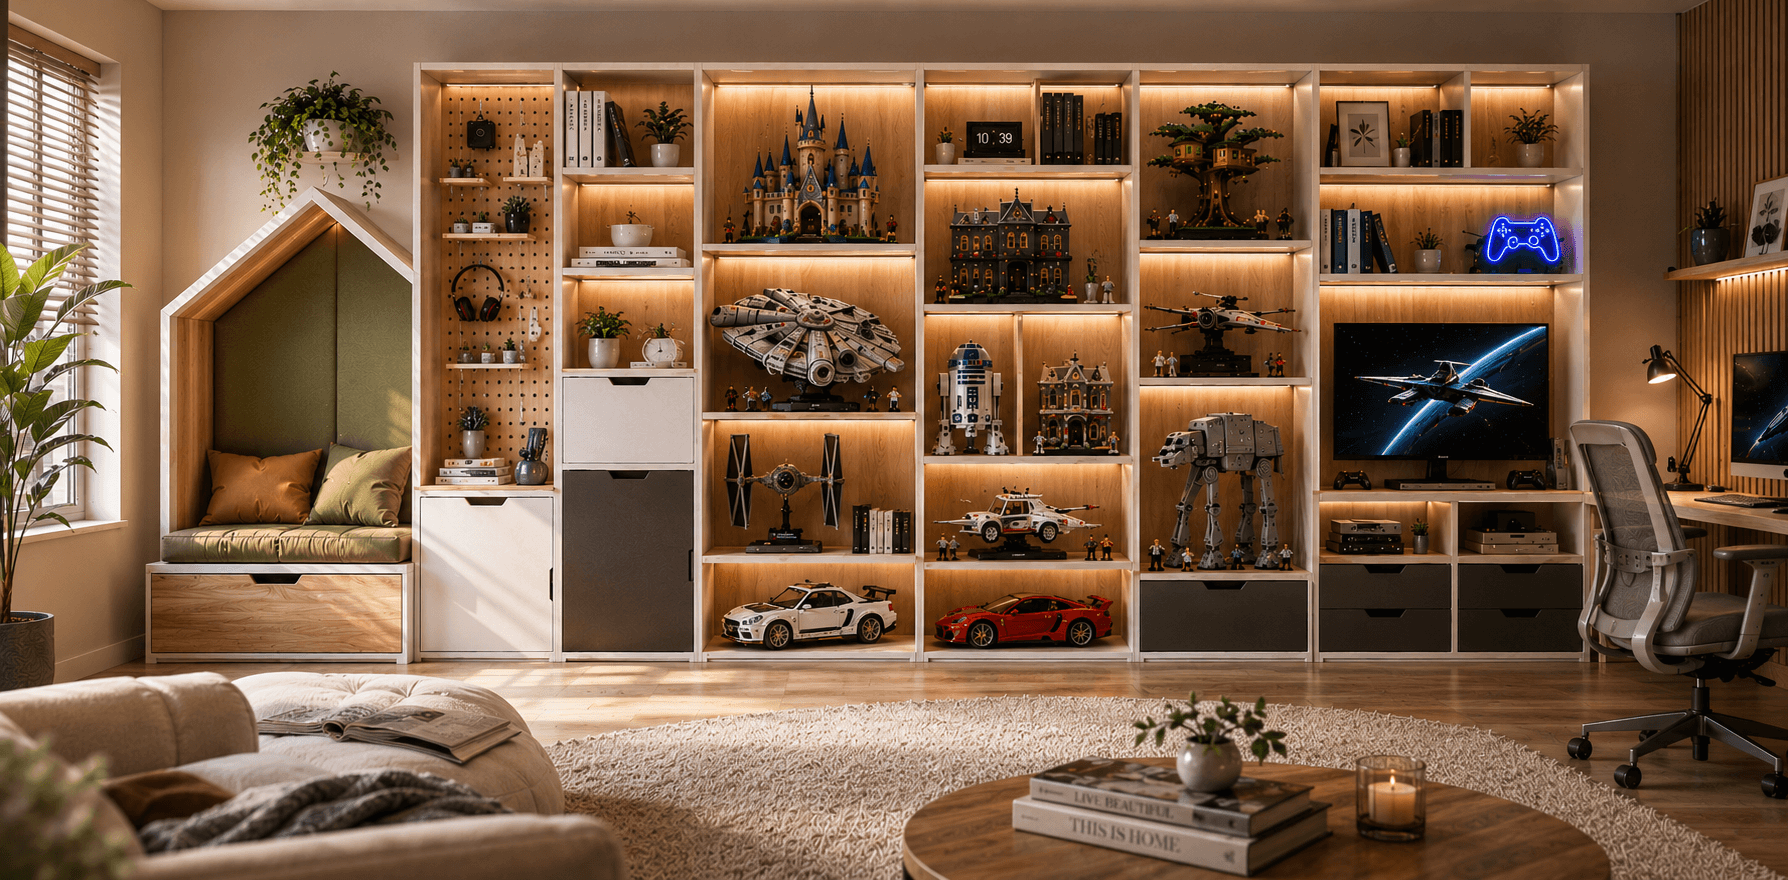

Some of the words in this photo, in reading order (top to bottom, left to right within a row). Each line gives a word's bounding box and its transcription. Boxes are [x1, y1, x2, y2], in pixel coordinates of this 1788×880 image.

[1074, 791, 1101, 807] LIVE
[1105, 796, 1174, 819] BEAUTIFUL
[1070, 816, 1108, 838] THIS
[1110, 823, 1126, 841] IS
[1128, 827, 1181, 853] HOME
